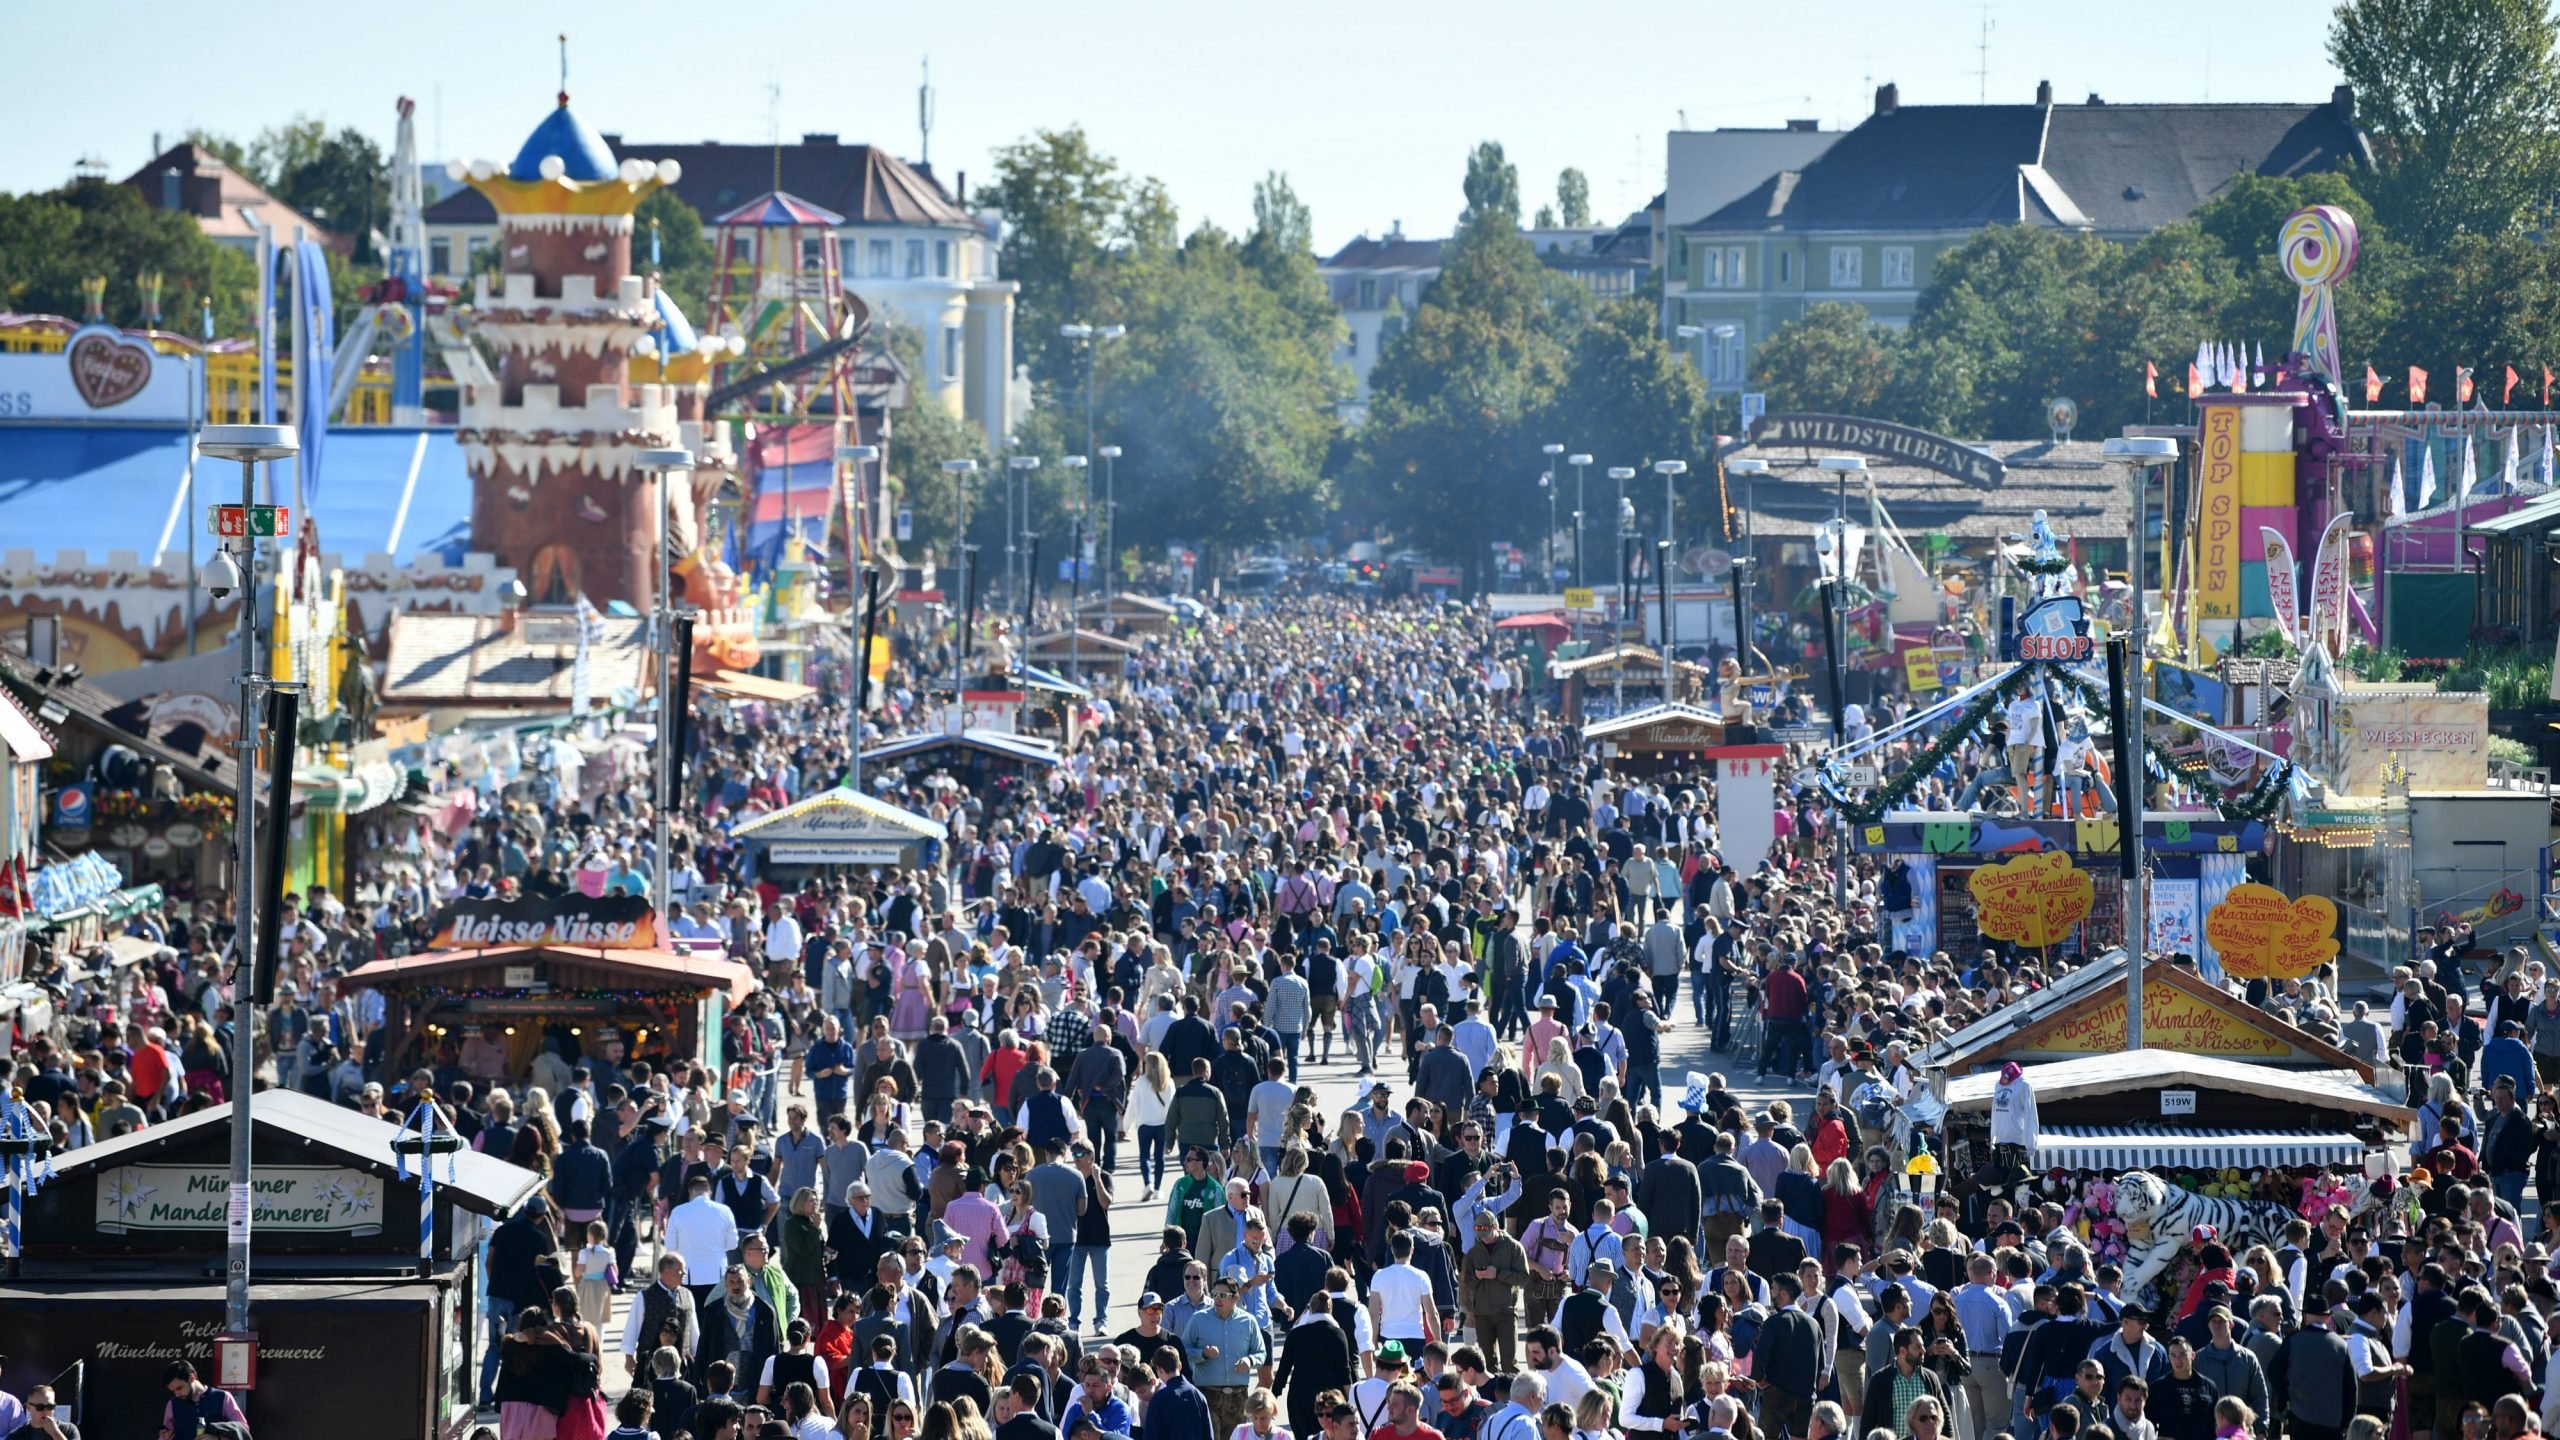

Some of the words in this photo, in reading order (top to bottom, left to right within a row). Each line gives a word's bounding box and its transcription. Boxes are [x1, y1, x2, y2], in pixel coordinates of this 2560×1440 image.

[1788, 420, 1970, 473] WILDSTUBEN
[2210, 412, 2234, 484] TOP
[2208, 495, 2231, 592] SPIN
[2021, 636, 2089, 660] SHOP
[1753, 691, 1775, 704] WC
[2366, 730, 2474, 744] WIESN-ECKEN
[2334, 815, 2386, 824] WIESN-EC
[1980, 864, 2045, 886] Gebrannte
[2026, 873, 2084, 894] Mandeln
[1985, 896, 2037, 915] Erdnüsse
[2228, 892, 2287, 910] Gebrannte
[2214, 905, 2289, 922] Macadamia
[451, 914, 545, 943] Heisse
[551, 912, 636, 943] Nüsse
[1990, 915, 2025, 933] Para
[2208, 923, 2268, 945] Walnüsse
[2221, 950, 2260, 970] Kürbis
[2061, 984, 2172, 1040] Wachiner's
[2146, 1007, 2225, 1032] Mandeln
[2198, 1031, 2252, 1049] Nüsse
[2165, 1098, 2191, 1106] 519W
[150, 1201, 332, 1223] Mandelennerei
[96, 1341, 182, 1359] Münchner
